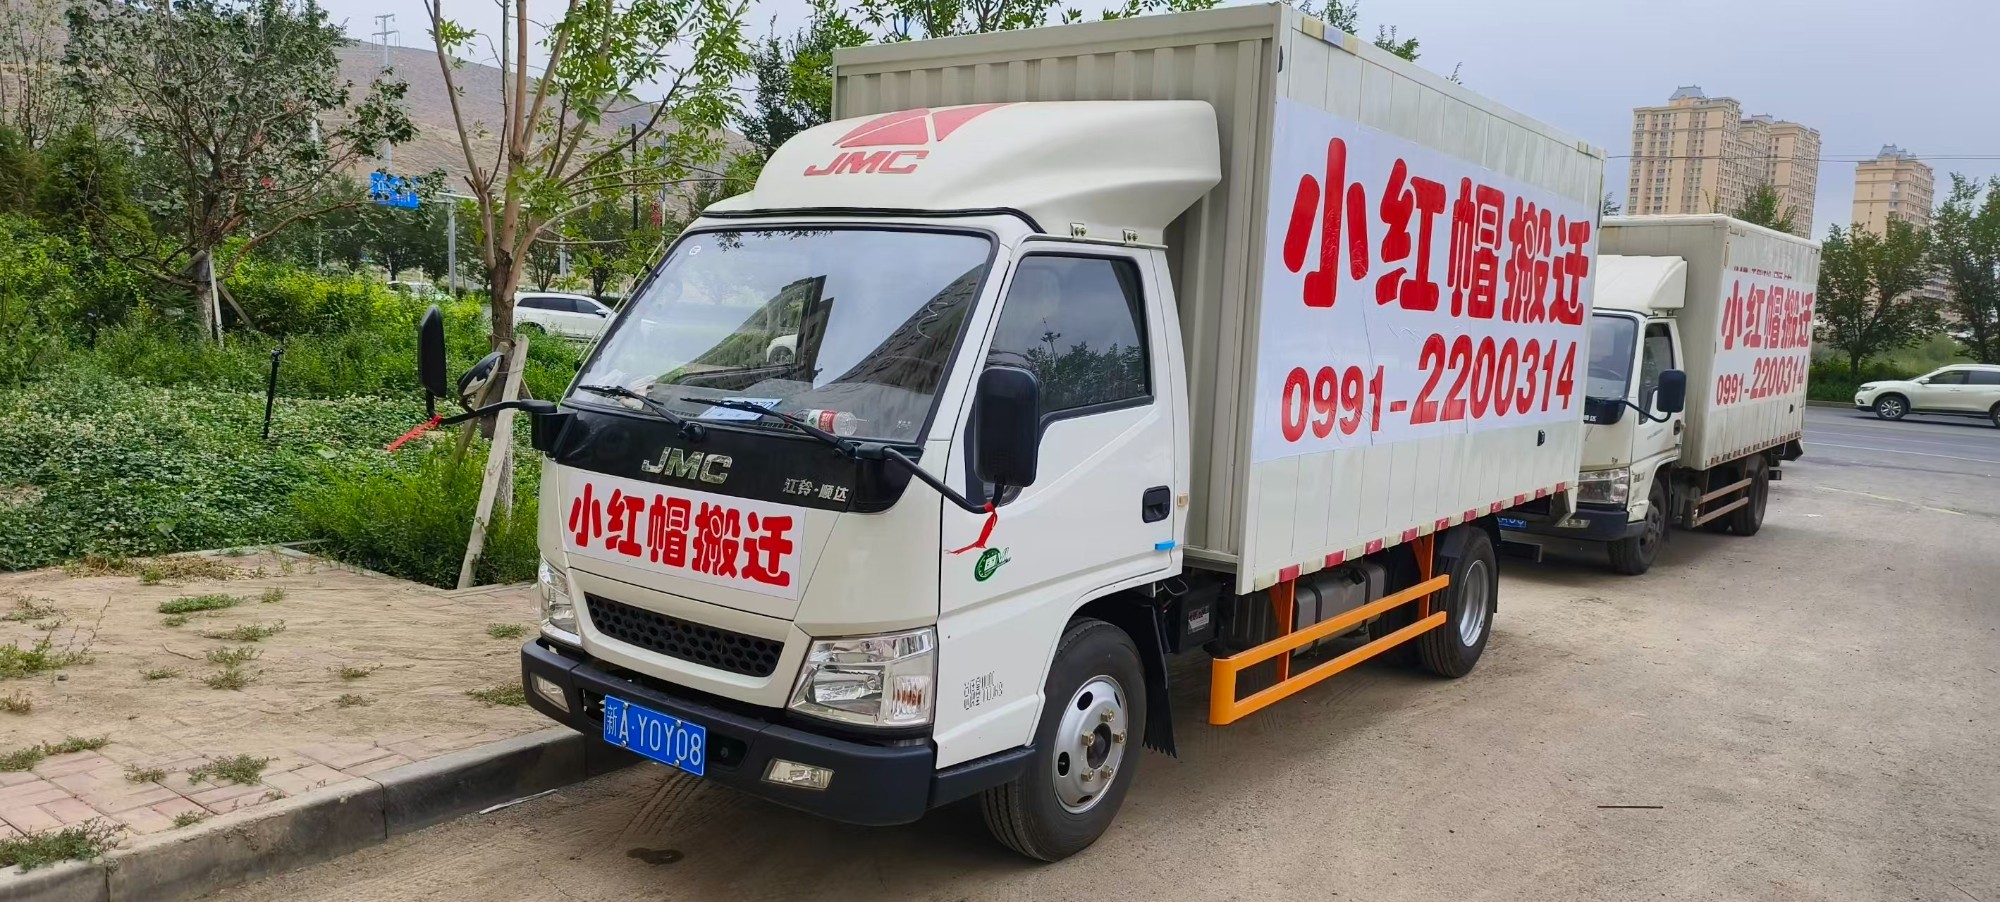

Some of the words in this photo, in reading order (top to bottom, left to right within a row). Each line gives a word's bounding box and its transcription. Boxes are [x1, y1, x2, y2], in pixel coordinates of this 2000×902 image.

[804, 151, 929, 176] JMC
[1283, 137, 1590, 325] 小红帽搬迁
[1721, 280, 1813, 350] 小红帽搬迁
[1281, 333, 1577, 442] 0991-2200314
[1716, 355, 1806, 406] 0991-2200314
[641, 446, 733, 484] JMC
[568, 483, 793, 587] 小红帽搬迁
